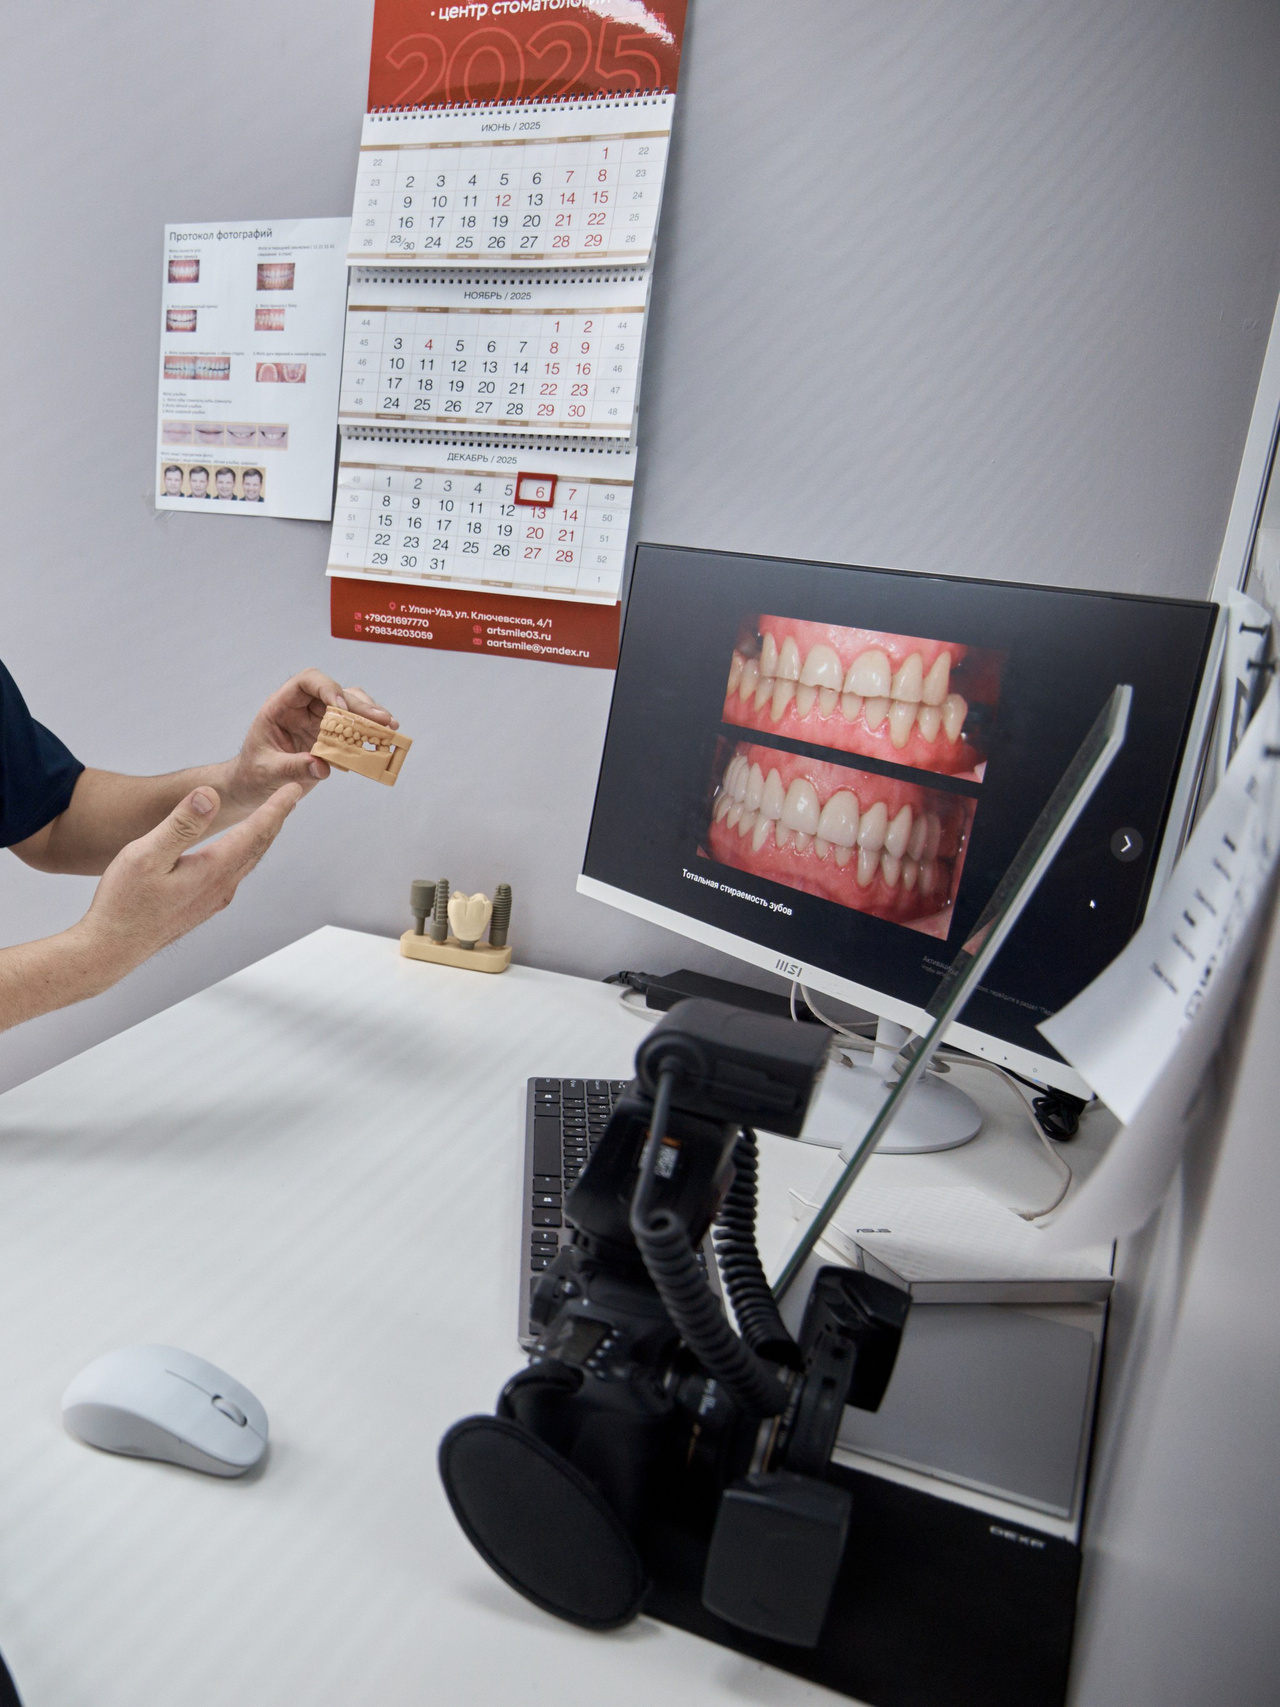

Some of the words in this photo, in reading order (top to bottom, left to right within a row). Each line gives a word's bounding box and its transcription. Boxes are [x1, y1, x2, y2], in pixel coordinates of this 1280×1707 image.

[438, 5, 488, 21] центр
[481, 123, 510, 132] ИЮНЬ
[518, 121, 541, 131] 2025
[372, 158, 383, 167] 22
[602, 147, 609, 160] 1
[637, 146, 650, 156] 22
[370, 178, 381, 187] 23
[405, 175, 415, 188] 2
[436, 174, 446, 188] 3
[468, 174, 477, 186] 4
[499, 173, 509, 186] 5
[532, 171, 542, 185] 6
[565, 170, 575, 184] 7
[597, 168, 608, 183] 8
[635, 168, 647, 178] 23
[367, 198, 378, 207] 24
[403, 196, 413, 209] 9
[431, 195, 448, 208] 10
[463, 195, 478, 207] 11
[494, 194, 512, 207] 12
[526, 193, 544, 207] 13
[559, 192, 576, 205] 14
[591, 190, 609, 204] 15
[632, 191, 643, 200] 24
[365, 218, 376, 227] 25
[398, 216, 414, 229] 16
[429, 215, 445, 228] 17
[460, 215, 477, 228] 18
[491, 215, 509, 228] 19
[522, 214, 541, 228] 20
[554, 213, 572, 227] 21
[587, 212, 607, 226] 22
[628, 212, 640, 222] 25
[169, 231, 214, 242] Протокол
[216, 227, 273, 241] фотографий
[362, 238, 374, 247] 26
[424, 236, 442, 249] 24
[455, 236, 474, 249] 25
[487, 235, 506, 249] 26
[519, 235, 539, 249] 27
[551, 234, 571, 248] 28
[583, 233, 603, 247] 29
[624, 234, 637, 244] 26
[464, 291, 503, 301] НОЯБРЬ
[510, 291, 532, 301] 2025
[361, 319, 371, 327] 44
[553, 320, 560, 333] 1
[583, 320, 593, 333] 2
[617, 321, 627, 329] 44
[359, 338, 369, 347] 45
[393, 337, 403, 350] 3
[424, 339, 433, 351] 4
[455, 339, 465, 352] 5
[487, 340, 496, 353] 6
[518, 341, 528, 353] 7
[549, 341, 559, 355] 8
[580, 341, 590, 355] 9
[614, 343, 625, 352] 45
[357, 358, 367, 367] 46
[388, 357, 405, 370] 10
[419, 358, 434, 371] 11
[450, 360, 467, 373] 12
[481, 360, 498, 374] 13
[512, 361, 529, 374] 14
[543, 362, 560, 375] 15
[575, 362, 592, 376] 16
[612, 364, 623, 373] 46
[355, 378, 365, 386] 47
[387, 377, 403, 389] 17
[416, 378, 433, 391] 18
[448, 380, 465, 393] 19
[477, 381, 496, 394] 20
[508, 382, 525, 395] 21
[539, 383, 558, 396] 22
[570, 383, 589, 397] 23
[610, 386, 621, 394] 47
[353, 397, 364, 406] 48
[383, 396, 400, 409] 24
[413, 398, 431, 411] 25
[444, 399, 462, 413] 26
[474, 401, 493, 414] 27
[506, 402, 524, 416] 28
[536, 403, 555, 417] 29
[567, 404, 586, 418] 30
[607, 407, 618, 416] 48
[447, 453, 489, 464] ДЕКАБРЬ
[496, 455, 518, 465] 2025
[351, 475, 361, 485] 49
[385, 476, 392, 488] 1
[413, 477, 423, 490] 2
[443, 479, 453, 492] 3
[473, 482, 482, 494] 4
[504, 484, 514, 496] 5
[535, 486, 545, 498] 6
[567, 488, 577, 501] 7
[604, 493, 616, 502] 49
[349, 494, 359, 503] 50
[382, 495, 391, 507] 8
[411, 497, 421, 510] 9
[438, 499, 454, 512] 10
[468, 502, 483, 514] 11
[499, 504, 516, 517] 12
[530, 506, 547, 519] 13
[562, 509, 578, 522] 14
[601, 513, 613, 523] 50
[347, 513, 356, 522] 51
[377, 514, 393, 527] 15
[406, 517, 422, 529] 16
[436, 519, 452, 531] 17
[466, 521, 482, 535] 18
[496, 524, 513, 537] 19
[525, 526, 545, 540] 20
[557, 529, 575, 542] 21
[599, 534, 609, 543] 51
[345, 532, 355, 541] 52
[374, 533, 391, 546] 22
[402, 535, 420, 549] 23
[432, 538, 449, 551] 24
[462, 541, 480, 554] 25
[492, 543, 511, 557] 26
[523, 546, 542, 559] 27
[555, 549, 574, 563] 28
[596, 555, 608, 564] 52
[371, 552, 389, 565] 29
[400, 555, 418, 568] 30
[429, 557, 445, 570] 31
[364, 612, 429, 628] +79021697770
[400, 604, 408, 613] г.
[408, 604, 454, 619] Улан-Удэ,
[455, 609, 470, 621] ул.
[470, 611, 535, 628] Ключевская,
[536, 617, 553, 628] 4/1
[364, 625, 433, 641] +79834203059
[486, 625, 552, 641] artsmile03.ru
[486, 638, 590, 658] aartsmile@yandex.ru
[681, 868, 719, 889] Тотальная
[719, 884, 768, 907] стираемость
[768, 900, 793, 916] зубов
